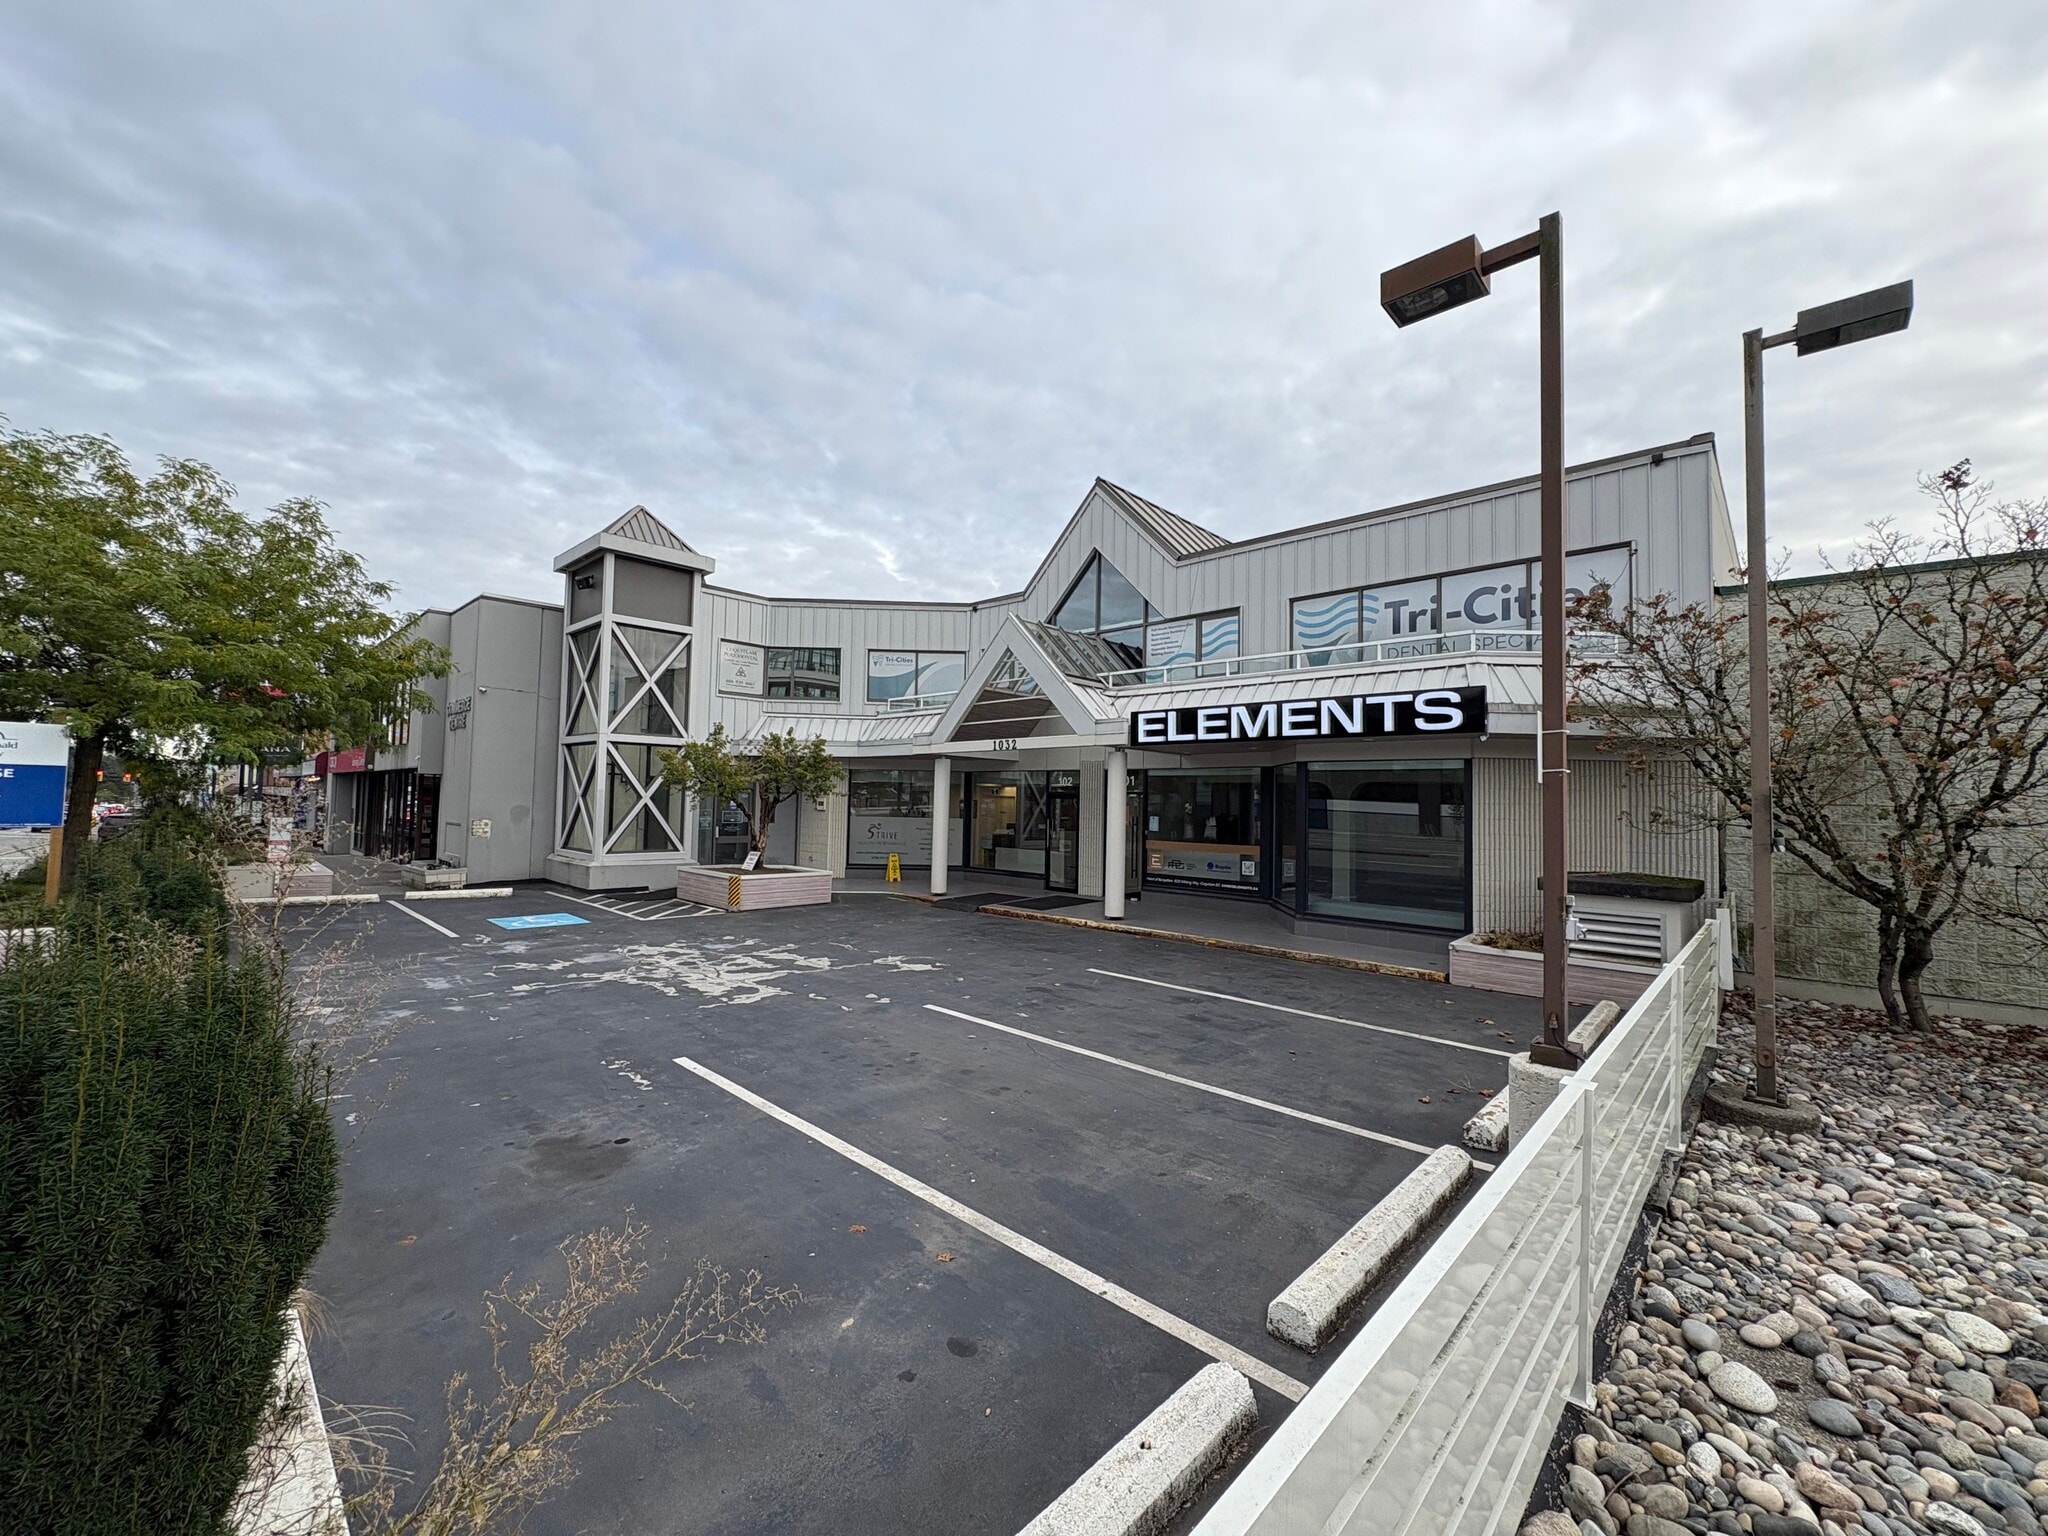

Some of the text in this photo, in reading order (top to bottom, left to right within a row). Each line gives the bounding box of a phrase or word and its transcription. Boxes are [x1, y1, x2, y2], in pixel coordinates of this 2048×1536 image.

[1387, 640, 1457, 659] DENTAL
[1136, 690, 1464, 743] ELEMENTS
[993, 740, 1017, 750] 1032
[1058, 777, 1073, 786] 102
